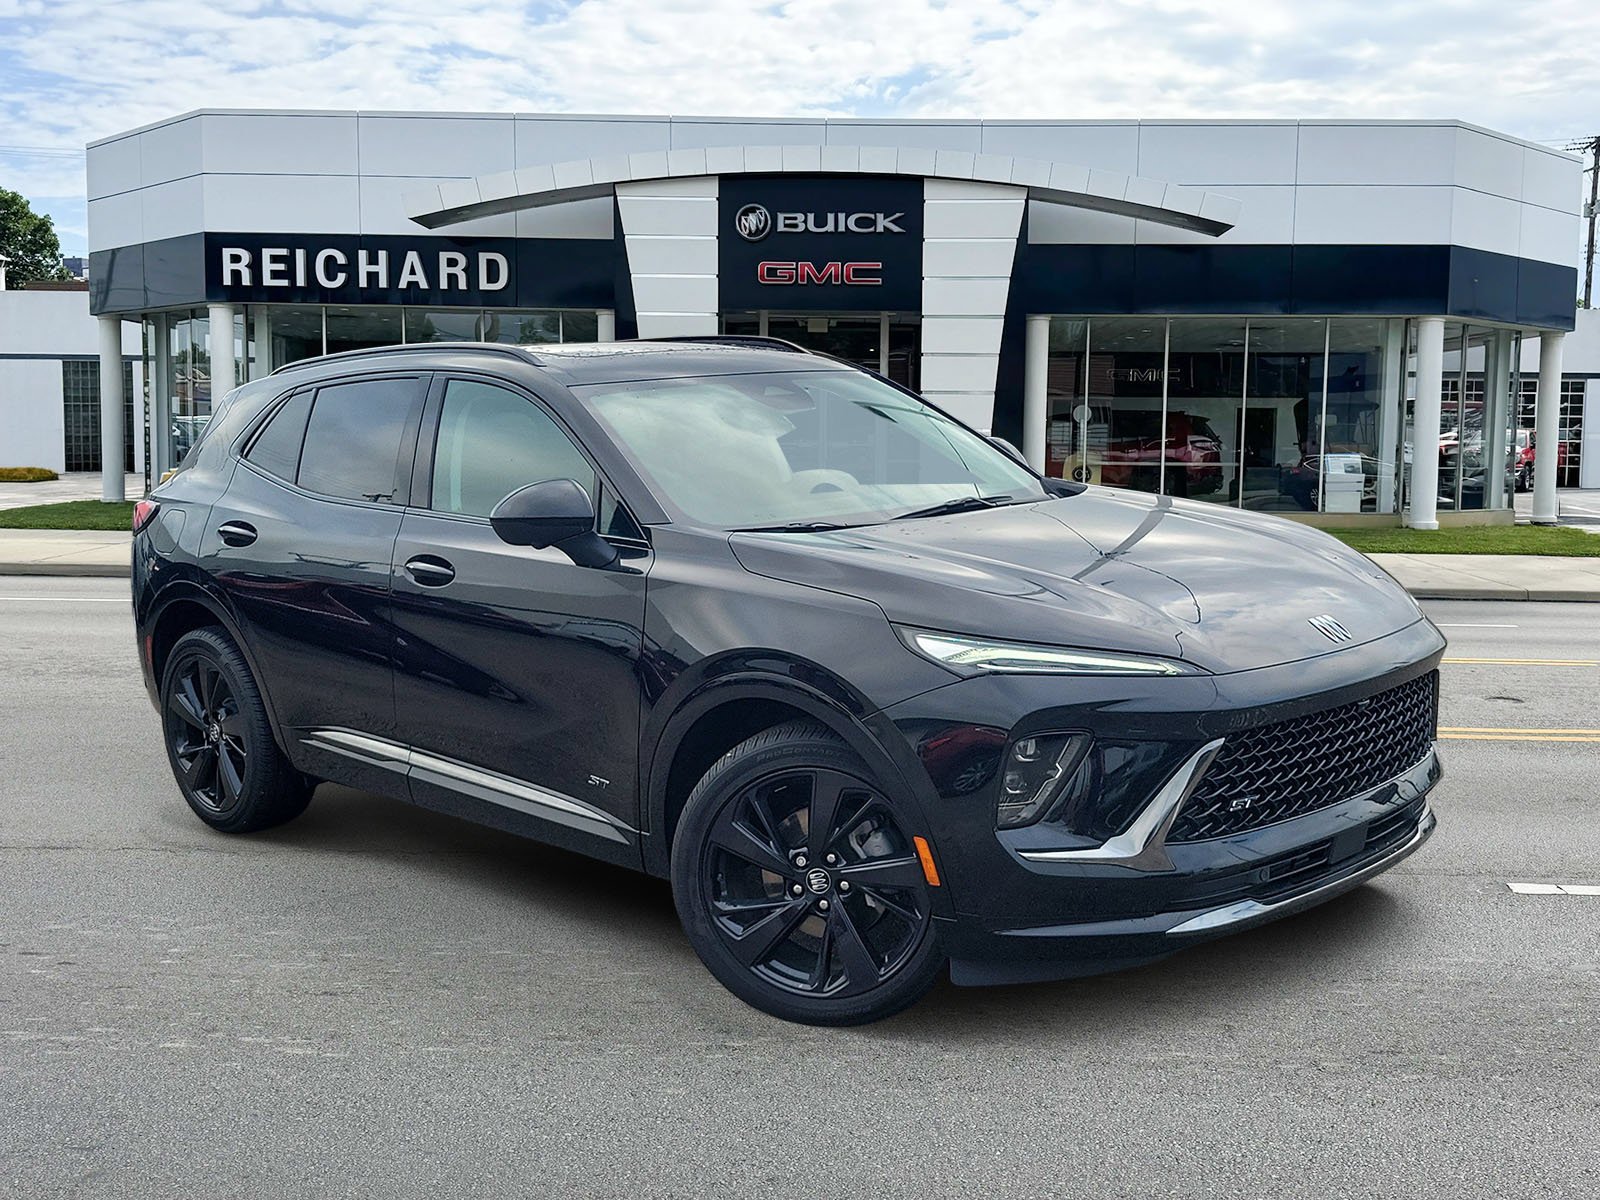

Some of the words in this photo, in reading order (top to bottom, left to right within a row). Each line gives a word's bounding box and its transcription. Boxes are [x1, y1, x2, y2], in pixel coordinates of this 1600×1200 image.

[777, 212, 906, 233] BUICK
[221, 247, 510, 291] REICHARD
[757, 261, 882, 285] GMC
[1106, 368, 1181, 382] GMC
[587, 774, 610, 789] ST
